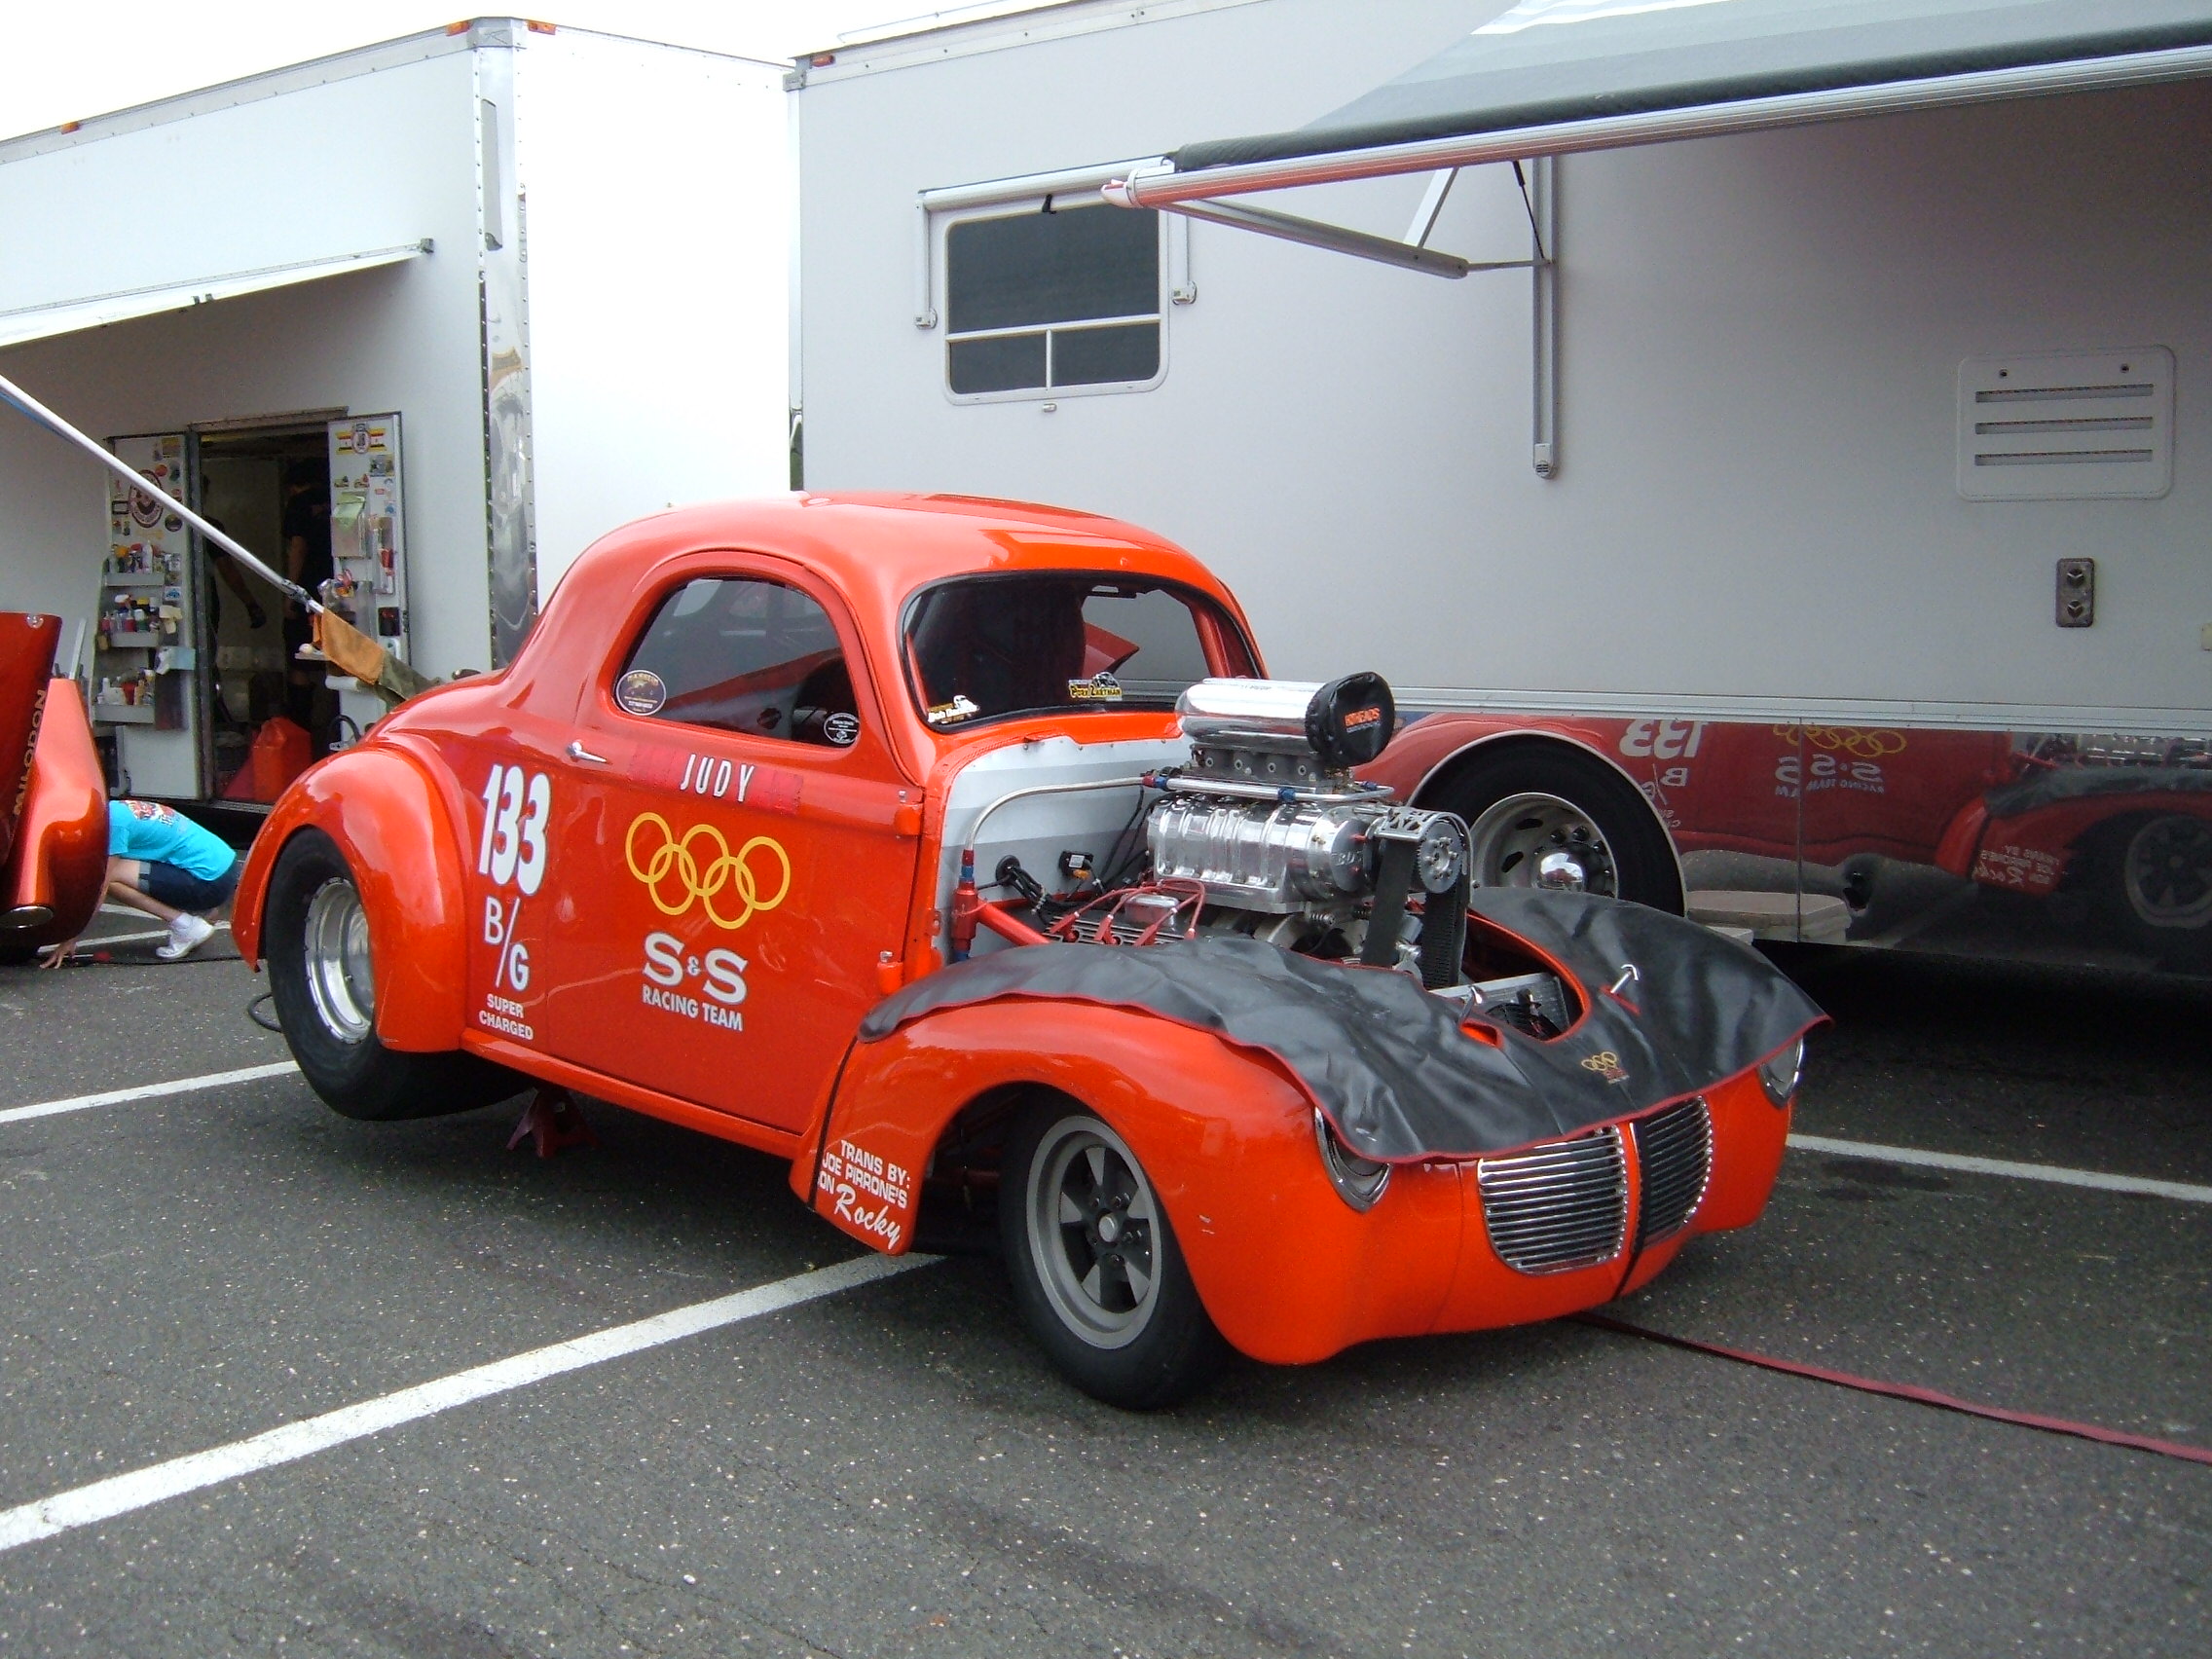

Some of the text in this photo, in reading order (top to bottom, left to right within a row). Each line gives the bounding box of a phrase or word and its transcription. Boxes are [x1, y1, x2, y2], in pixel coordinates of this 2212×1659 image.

[680, 754, 756, 802] JUDY
[478, 763, 552, 895] 133
[478, 1010, 534, 1041] CHARGED
[487, 993, 525, 1018] SUPER
[643, 983, 744, 1031] RACING TEAM
[822, 1152, 907, 1209] JOE PIRRONE'S
[840, 1139, 911, 1189] TRANS BY:
[819, 1170, 901, 1250] ON Rocky
